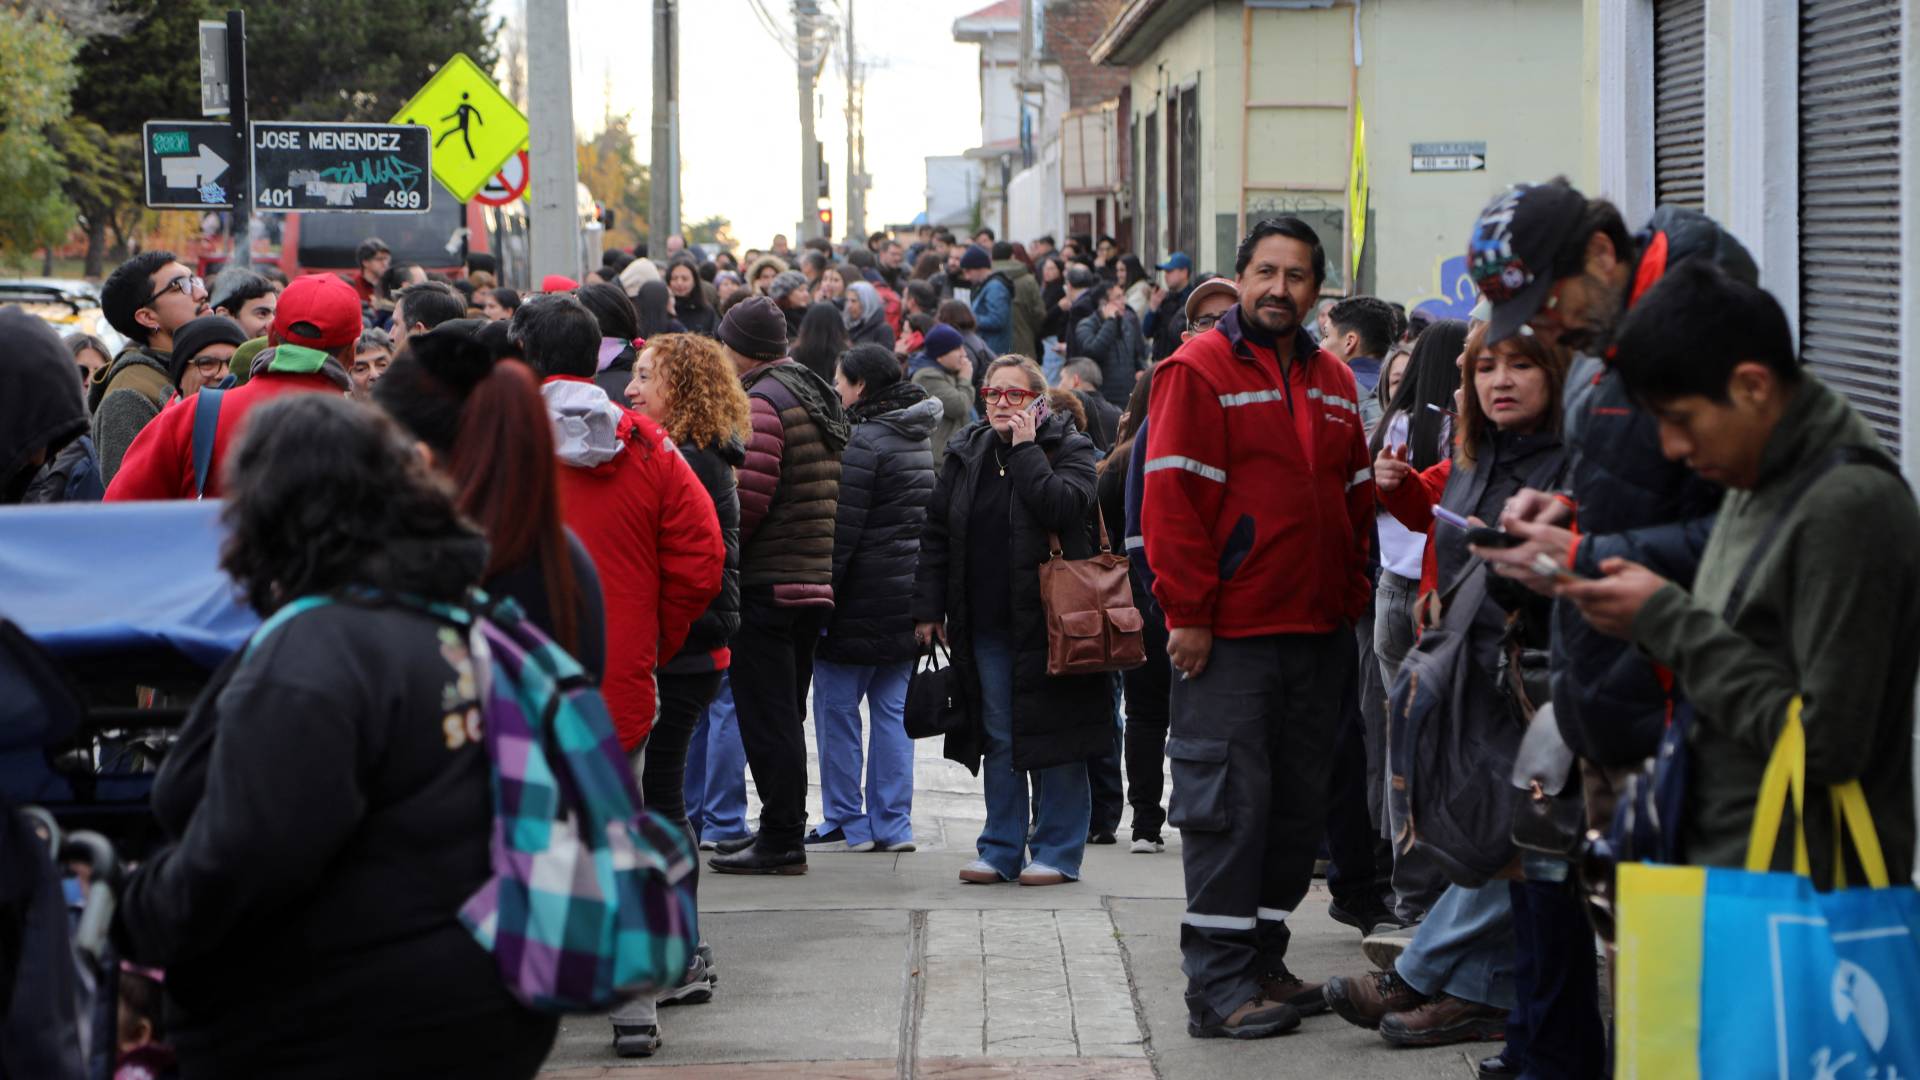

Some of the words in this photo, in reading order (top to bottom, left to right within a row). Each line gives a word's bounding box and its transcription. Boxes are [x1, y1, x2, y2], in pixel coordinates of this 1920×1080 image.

[256, 131, 300, 149] JOSE
[309, 131, 401, 151] MENENDEZ
[259, 188, 293, 207] 401
[383, 190, 421, 209] 499
